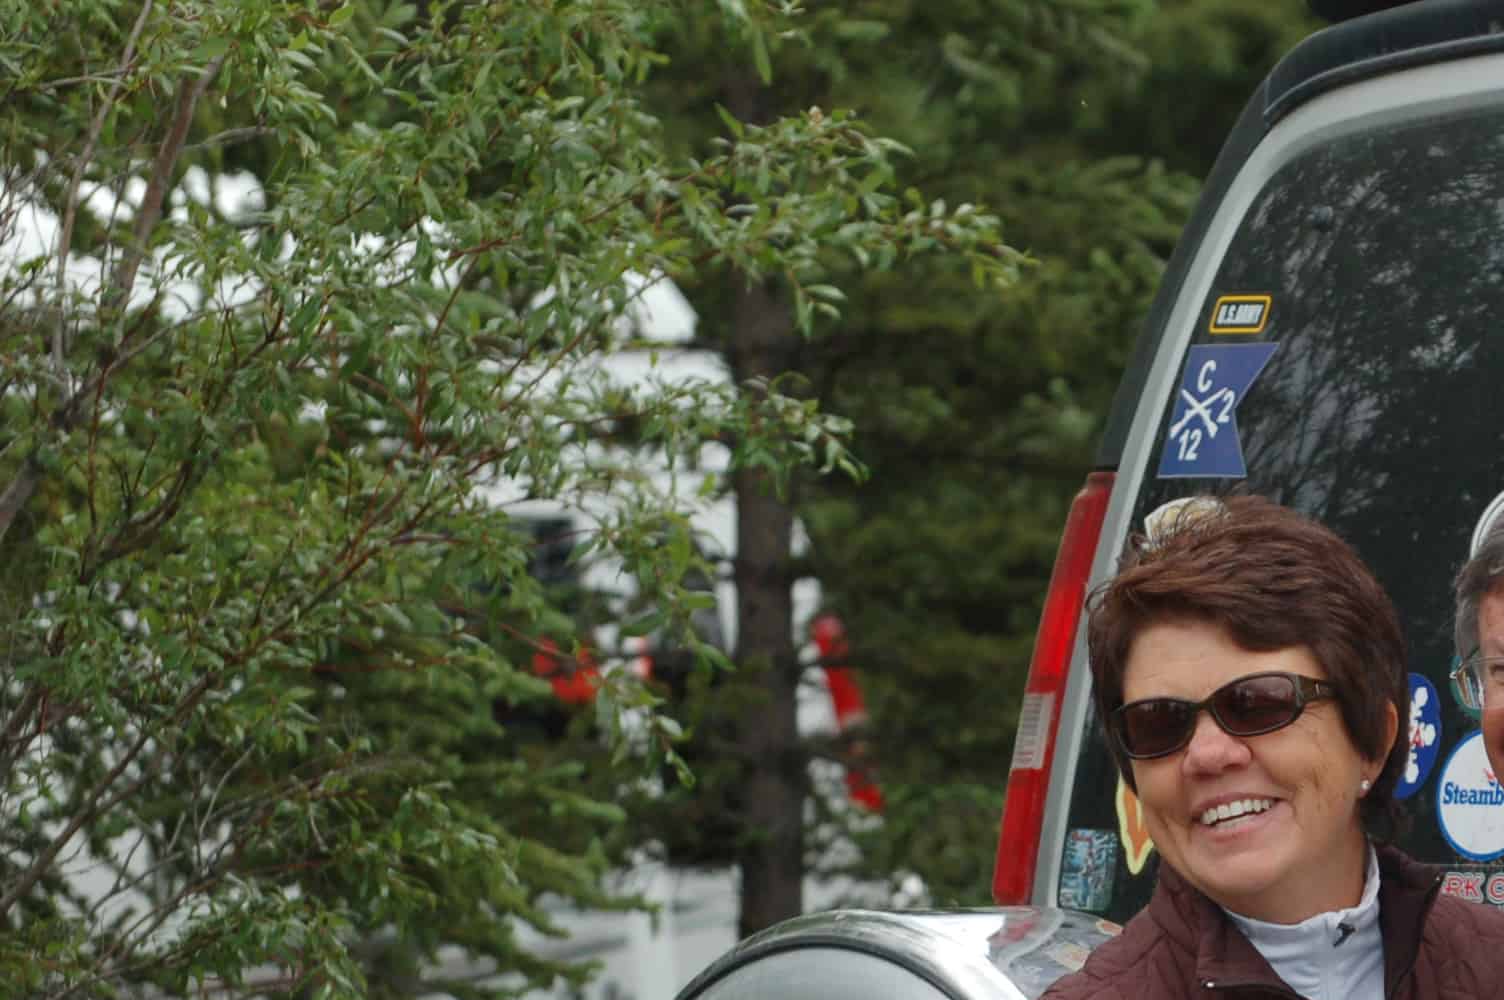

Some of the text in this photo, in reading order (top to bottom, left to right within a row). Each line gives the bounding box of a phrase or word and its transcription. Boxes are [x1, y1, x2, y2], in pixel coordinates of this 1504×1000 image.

[1197, 359, 1216, 393] C
[1217, 389, 1235, 423] 2
[1178, 429, 1202, 461] 12
